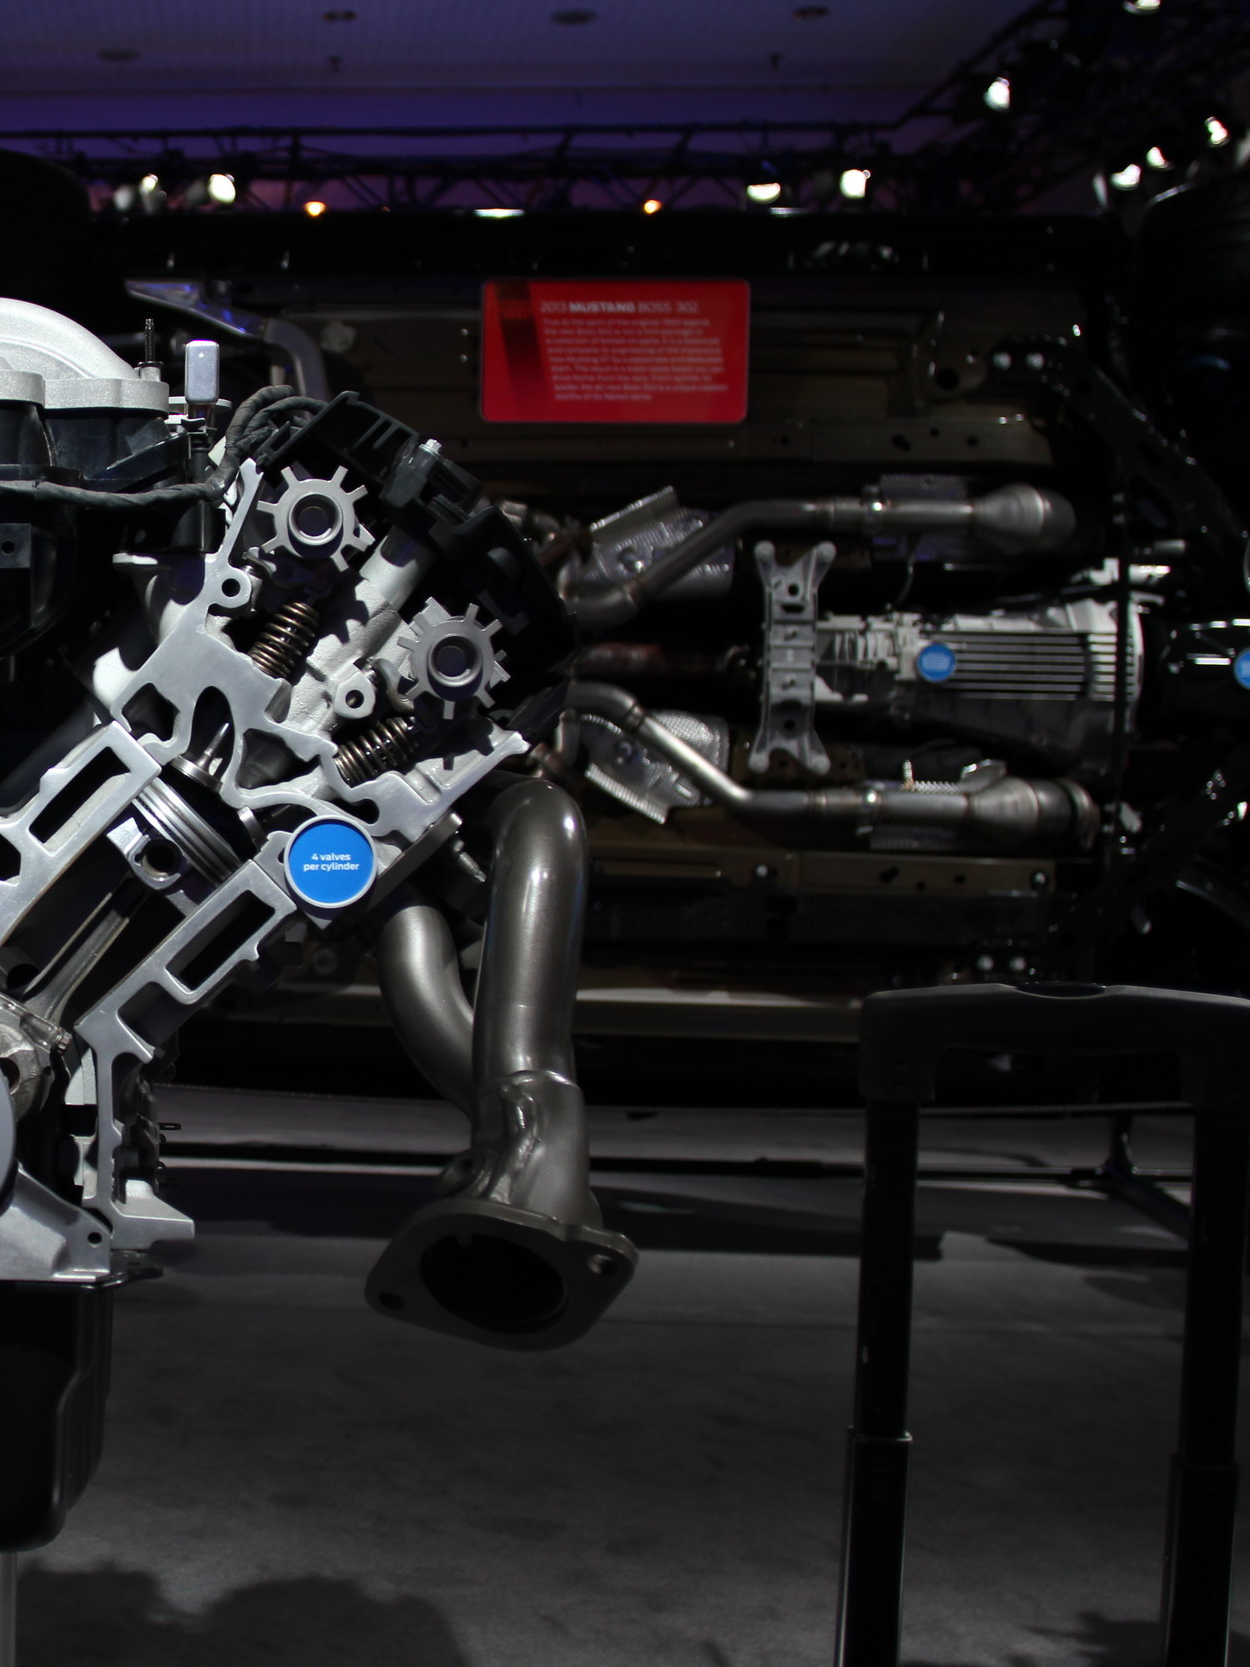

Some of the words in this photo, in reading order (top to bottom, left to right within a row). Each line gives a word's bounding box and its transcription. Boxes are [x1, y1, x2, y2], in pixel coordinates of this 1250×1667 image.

[569, 300, 635, 314] MUSTANG
[637, 300, 672, 314] BOSS
[311, 853, 319, 861] 4
[320, 852, 351, 861] valves
[303, 863, 320, 872] per
[321, 862, 360, 872] cylinder
